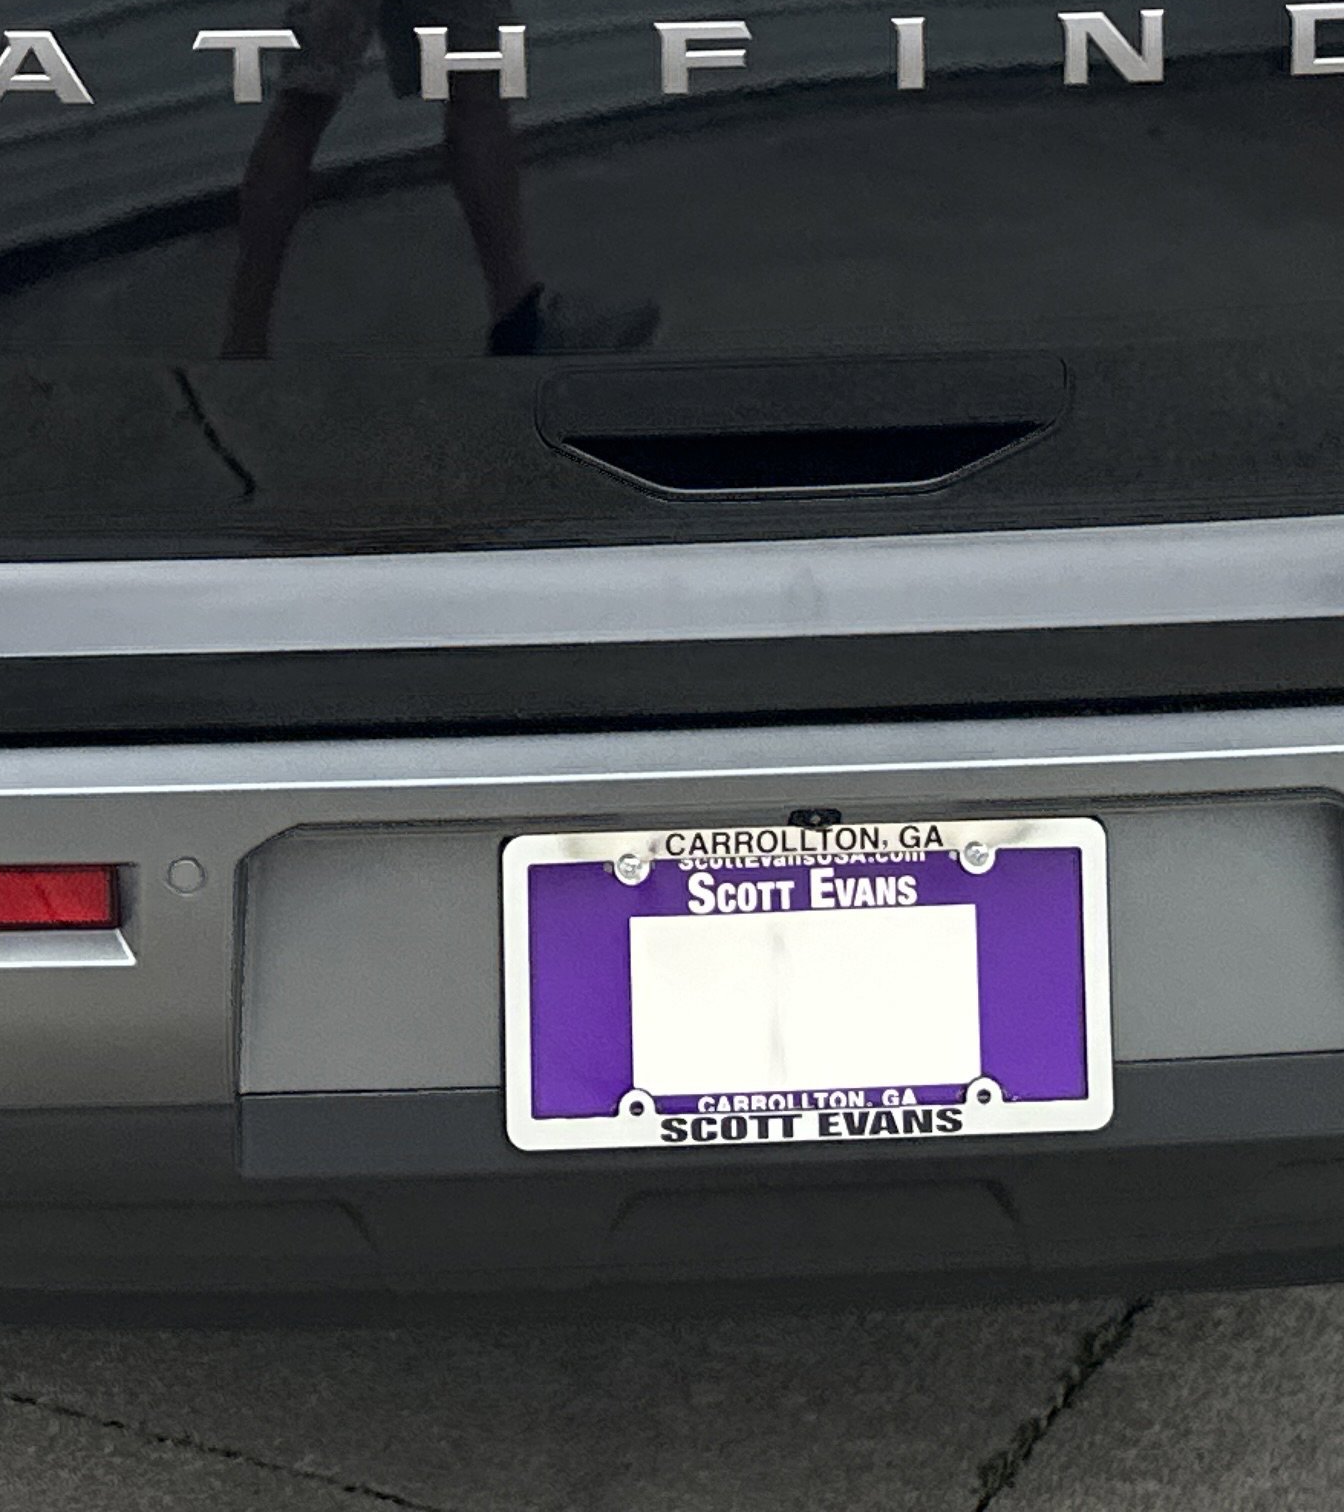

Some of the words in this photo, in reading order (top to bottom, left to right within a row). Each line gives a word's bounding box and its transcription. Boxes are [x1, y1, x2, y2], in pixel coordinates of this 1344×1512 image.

[665, 826, 888, 856] CARROLLTON,
[899, 825, 944, 849] GA
[882, 1087, 918, 1106] GA
[660, 1113, 803, 1143] SCOTT
[818, 1108, 964, 1138] EVANS
